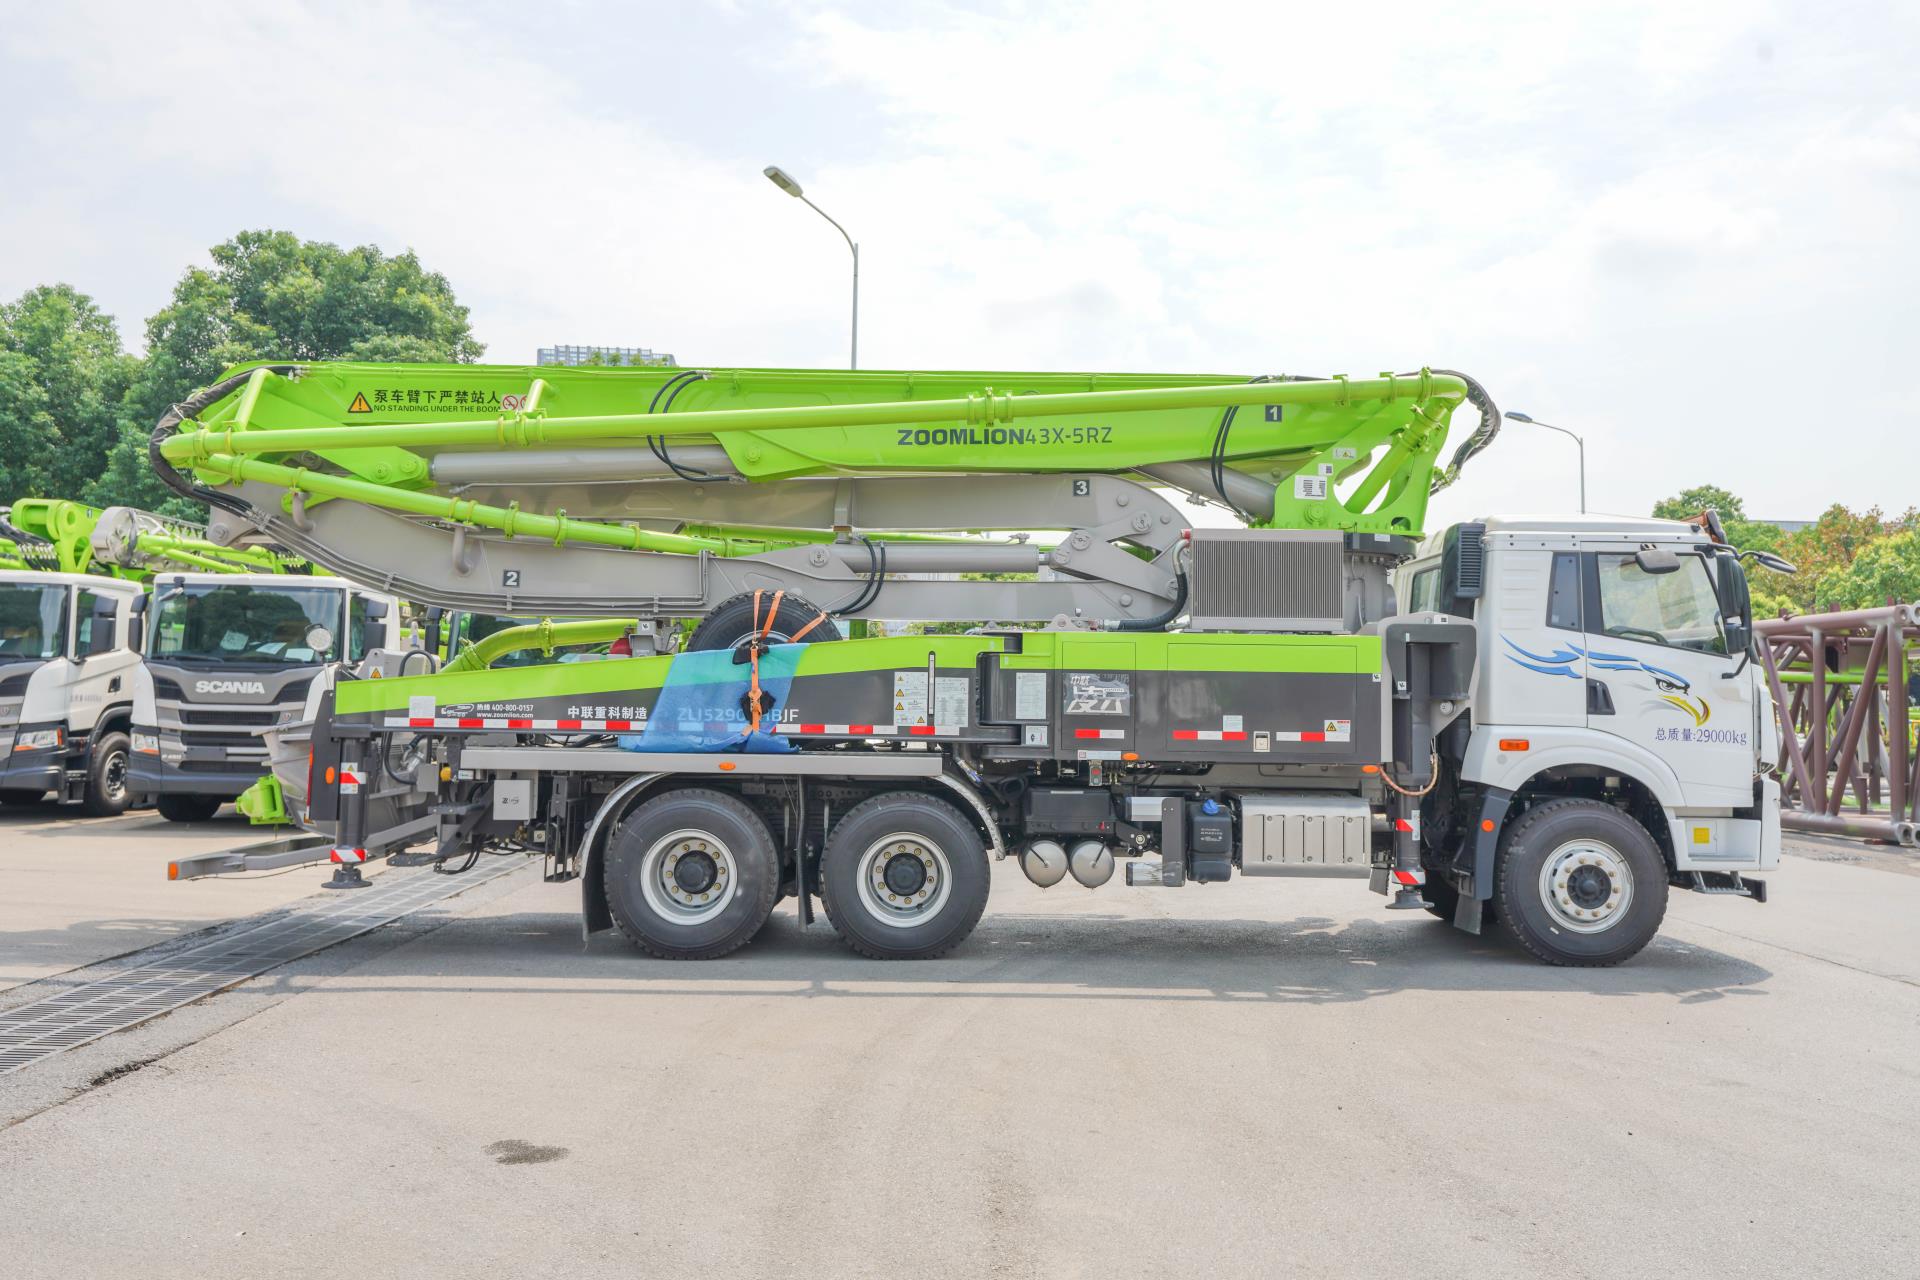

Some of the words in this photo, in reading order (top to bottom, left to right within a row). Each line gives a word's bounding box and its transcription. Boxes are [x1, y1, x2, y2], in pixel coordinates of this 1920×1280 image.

[374, 389, 500, 404] 泵车臂下严禁站人
[373, 404, 386, 412] NO
[459, 405, 475, 413] THE
[476, 405, 500, 413] BOOM
[1269, 406, 1278, 421] 1
[1076, 480, 1088, 495] 3
[505, 571, 518, 586] 2
[195, 681, 265, 694] SCANIA
[567, 706, 648, 719] 中联重科制造
